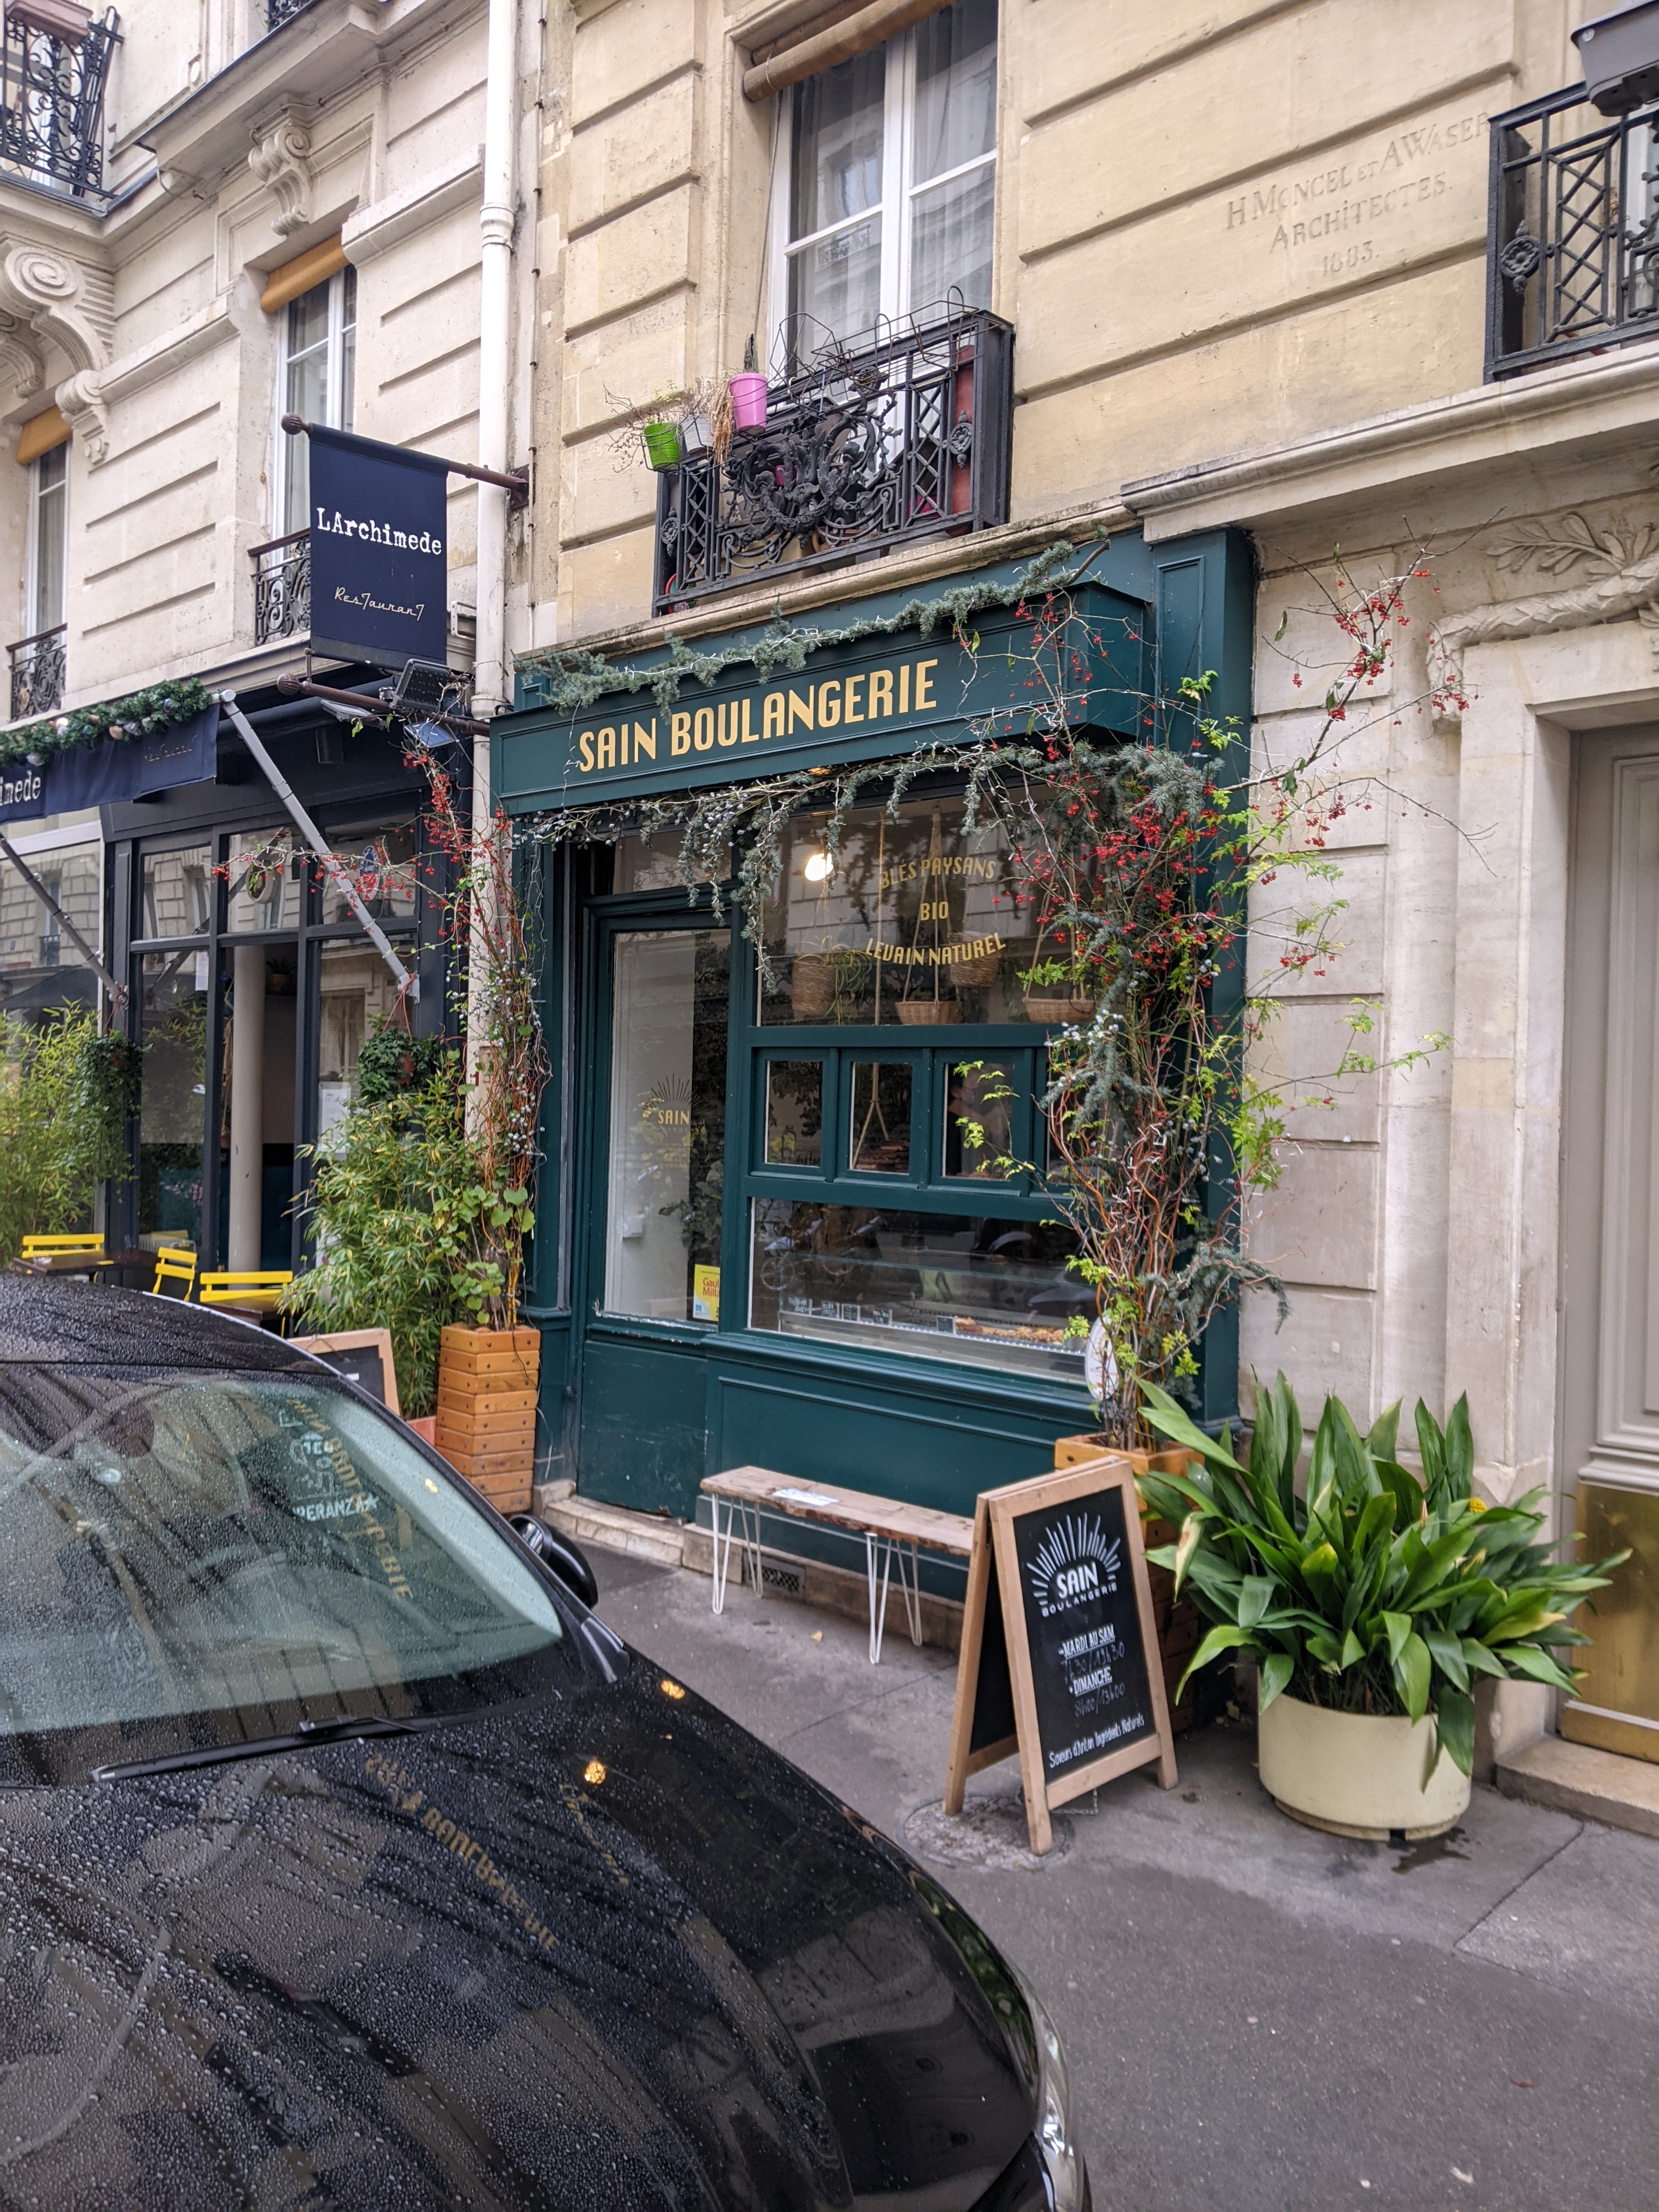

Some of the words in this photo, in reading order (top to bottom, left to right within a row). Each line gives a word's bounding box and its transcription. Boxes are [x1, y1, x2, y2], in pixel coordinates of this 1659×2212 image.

[579, 718, 657, 772] SAIN
[671, 659, 939, 756] BOULANGERIE
[880, 859, 917, 890] BLÉS
[921, 857, 996, 879] PAYSANS
[920, 901, 949, 921] BIO
[865, 937, 926, 966] LEVAIN
[928, 932, 1007, 966] NATUREL
[658, 1109, 690, 1125] SAIN
[1057, 1561, 1099, 1599] SAIN
[1041, 1582, 1118, 1618] BOULANGERIE
[1073, 1666, 1113, 1696] DIMANCHE
